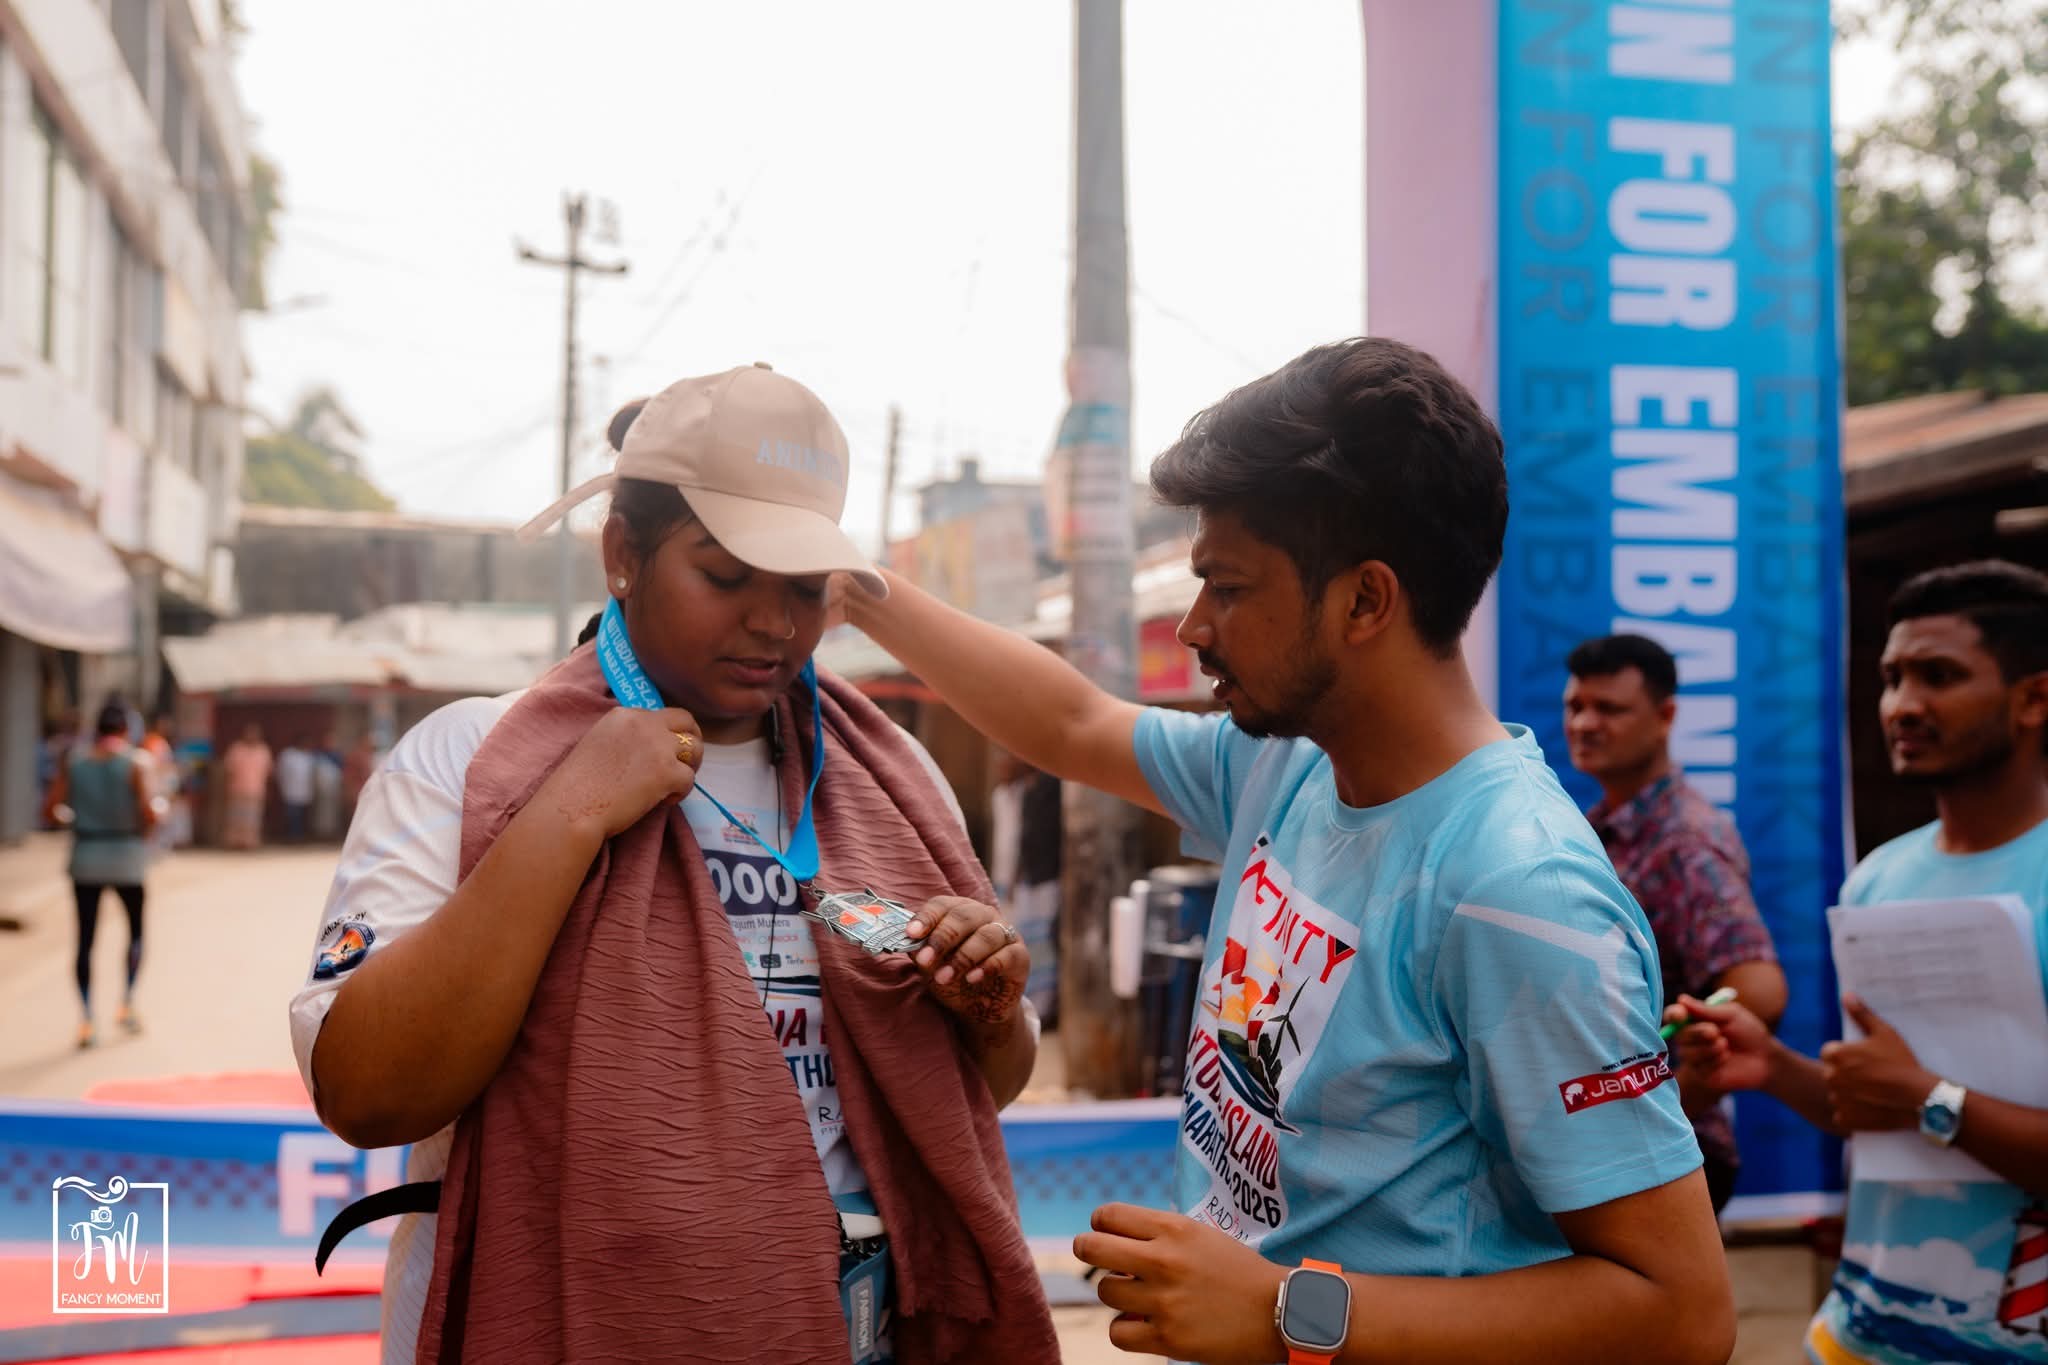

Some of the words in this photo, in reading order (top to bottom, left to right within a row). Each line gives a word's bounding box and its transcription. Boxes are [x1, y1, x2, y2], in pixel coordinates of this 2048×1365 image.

[1608, 117, 1737, 330] FOR
[1220, 1097, 1279, 1191] ISLAND
[1230, 1170, 1282, 1229] 2026
